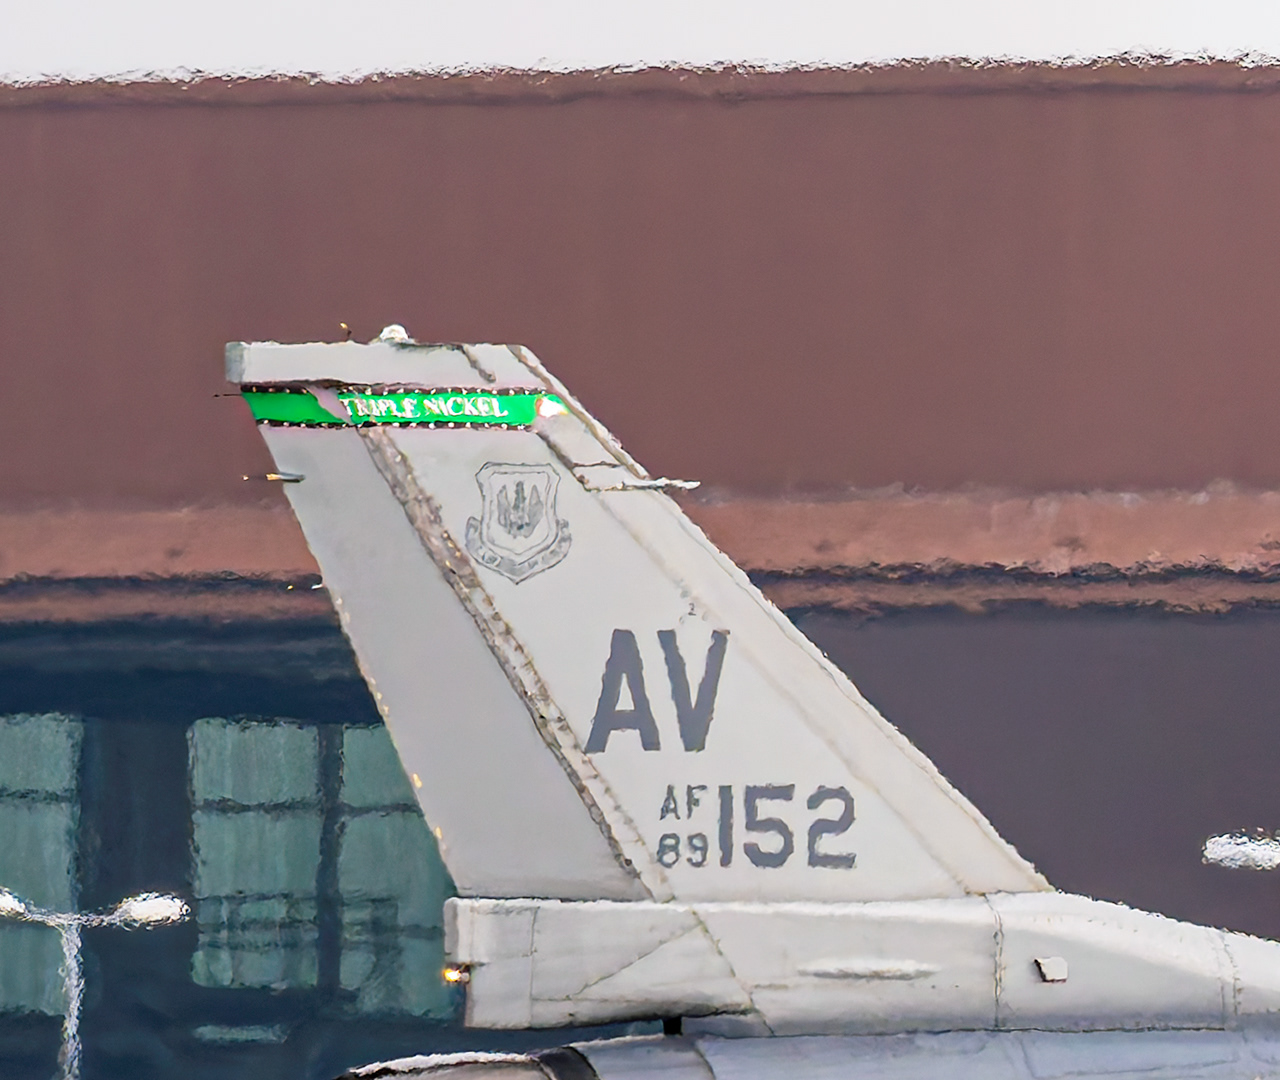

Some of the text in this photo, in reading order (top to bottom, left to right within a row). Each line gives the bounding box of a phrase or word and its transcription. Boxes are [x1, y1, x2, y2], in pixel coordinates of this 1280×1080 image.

[339, 396, 509, 418] TRIPLE NICKEL
[584, 628, 730, 753] AV
[659, 784, 708, 821] AF
[717, 783, 858, 869] 152
[656, 832, 708, 869] 89
